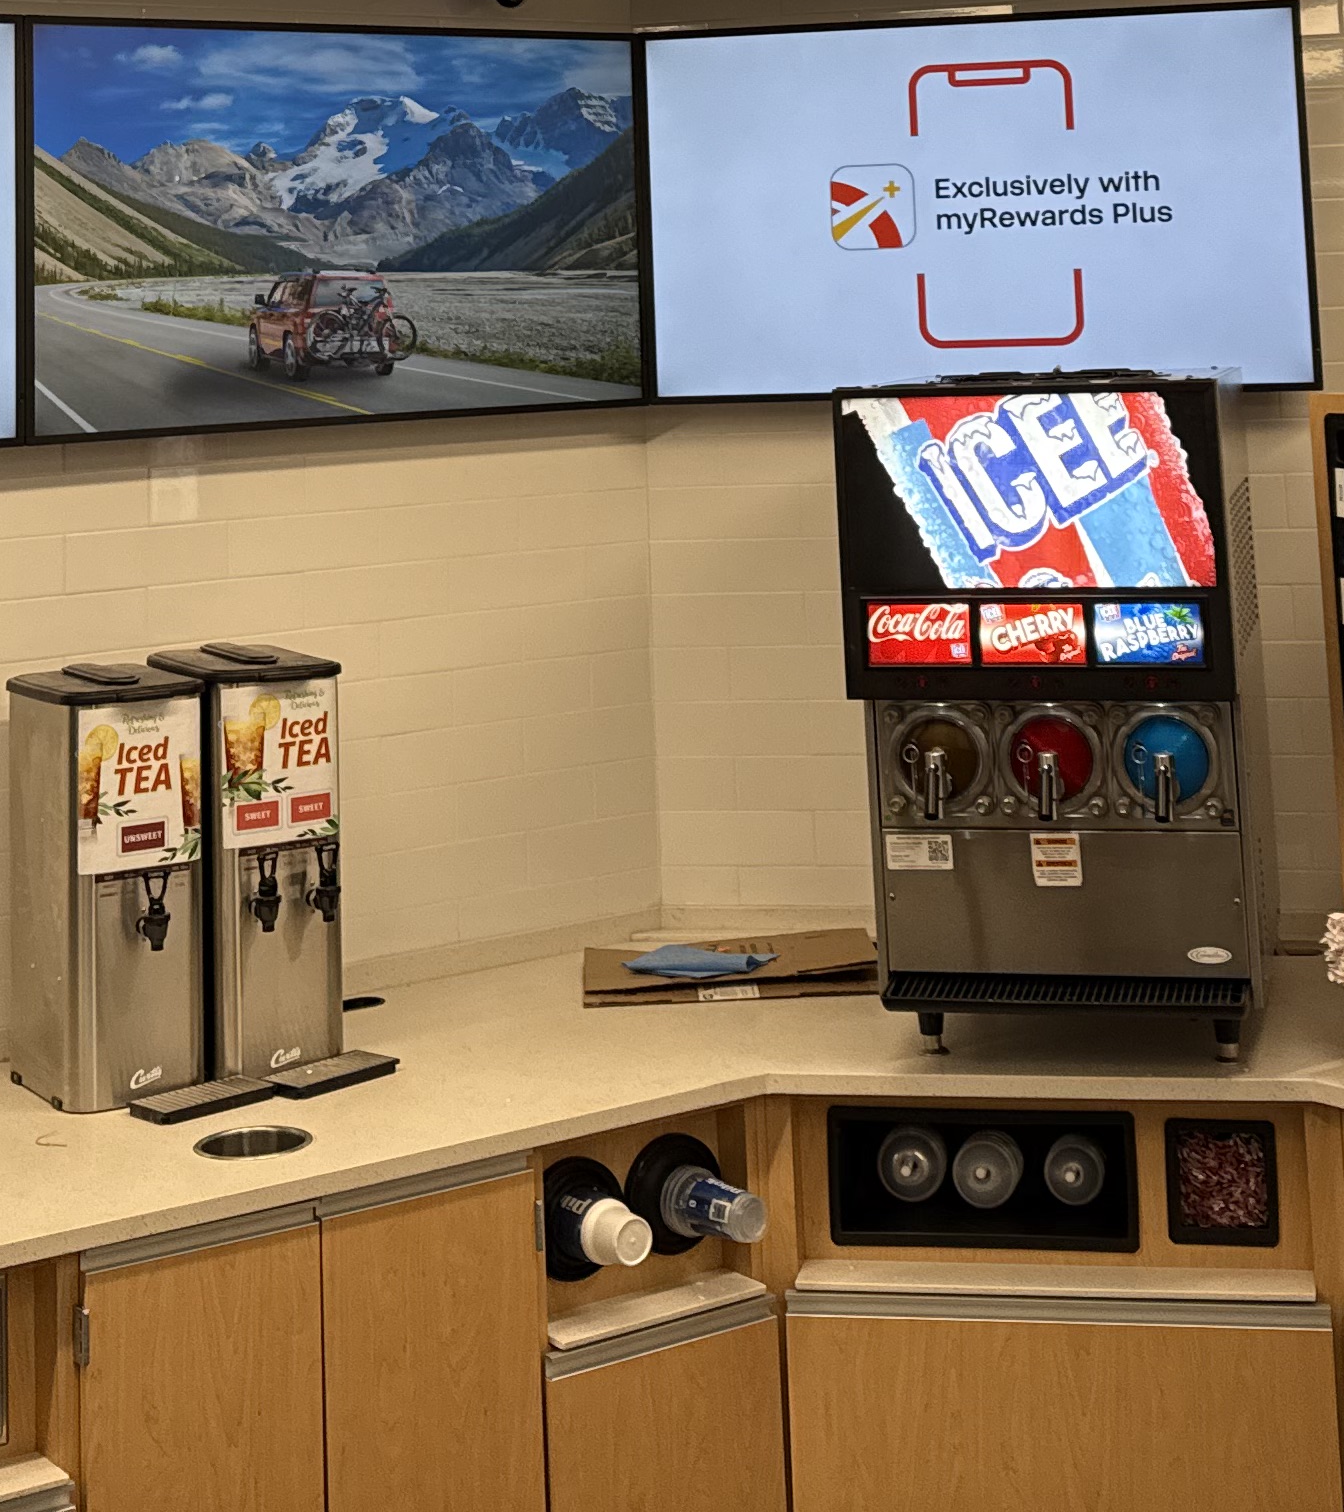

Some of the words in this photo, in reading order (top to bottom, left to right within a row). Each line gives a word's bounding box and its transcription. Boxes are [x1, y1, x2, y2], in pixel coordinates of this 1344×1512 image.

[934, 173, 1090, 200] Exclusively
[1099, 170, 1160, 192] with
[936, 204, 1104, 235] myRewards
[1113, 202, 1173, 224] Plus
[918, 391, 1148, 563] ICEE
[868, 603, 969, 642] Coca-Cola
[991, 607, 1074, 651] CHERRY
[1123, 613, 1168, 634] BLUE
[1100, 624, 1198, 662] RASPBERRY
[281, 711, 329, 739] Iced
[117, 736, 169, 765] Iced
[278, 737, 332, 769] TEA
[114, 763, 172, 796] TEA
[244, 809, 271, 821] SWEET
[298, 802, 324, 814] SWEET
[123, 830, 163, 844] UNSWEET
